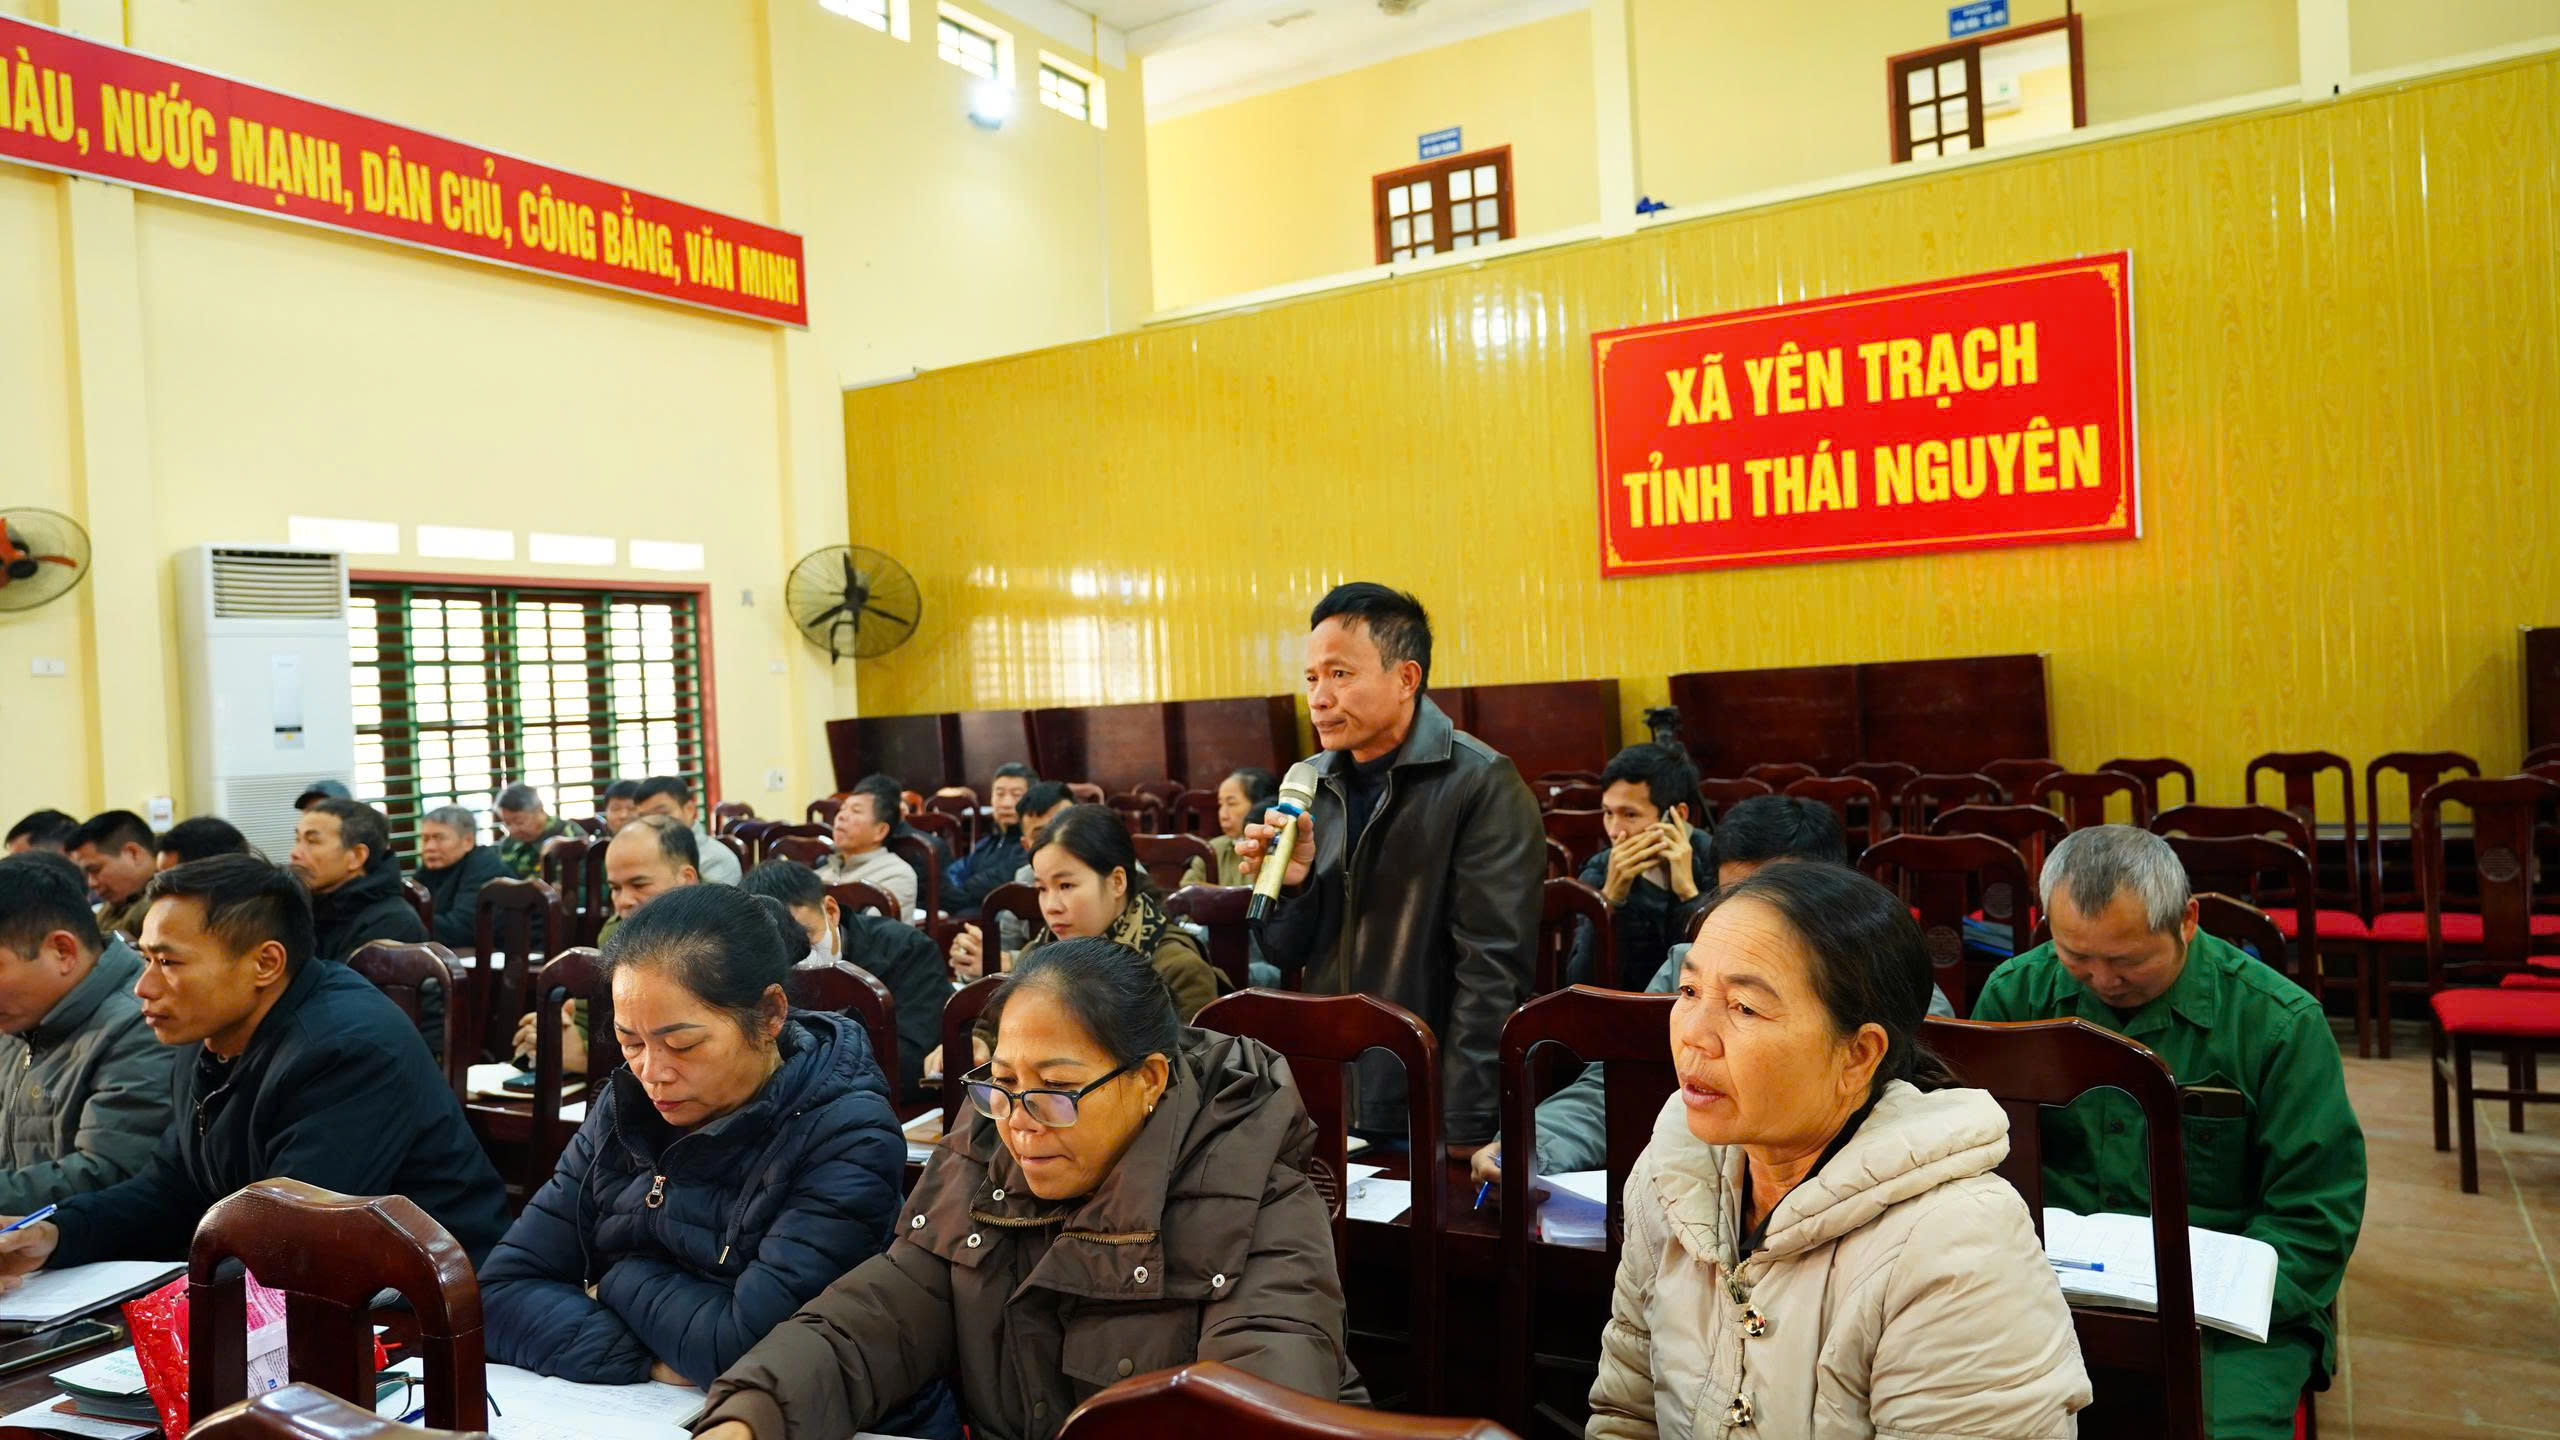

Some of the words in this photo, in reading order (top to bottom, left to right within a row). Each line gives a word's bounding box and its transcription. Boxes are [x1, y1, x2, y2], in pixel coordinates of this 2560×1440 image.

[100, 81, 219, 177] NƯỚC
[227, 115, 354, 215] MẠNH,
[359, 144, 433, 225] DÂN
[439, 156, 513, 250] CHỦ,
[517, 183, 598, 261] CÔNG
[601, 189, 682, 286] BẰNG,
[684, 224, 735, 292] VĂN
[738, 244, 799, 306] MINH
[1665, 351, 1733, 428] XÃ
[1743, 341, 1844, 417] YÊN
[1857, 321, 2038, 409] TRẠCH
[1621, 450, 1732, 529] TỈNH
[1743, 439, 1858, 518] THÁI
[1874, 415, 2101, 506] NGUYÊN
